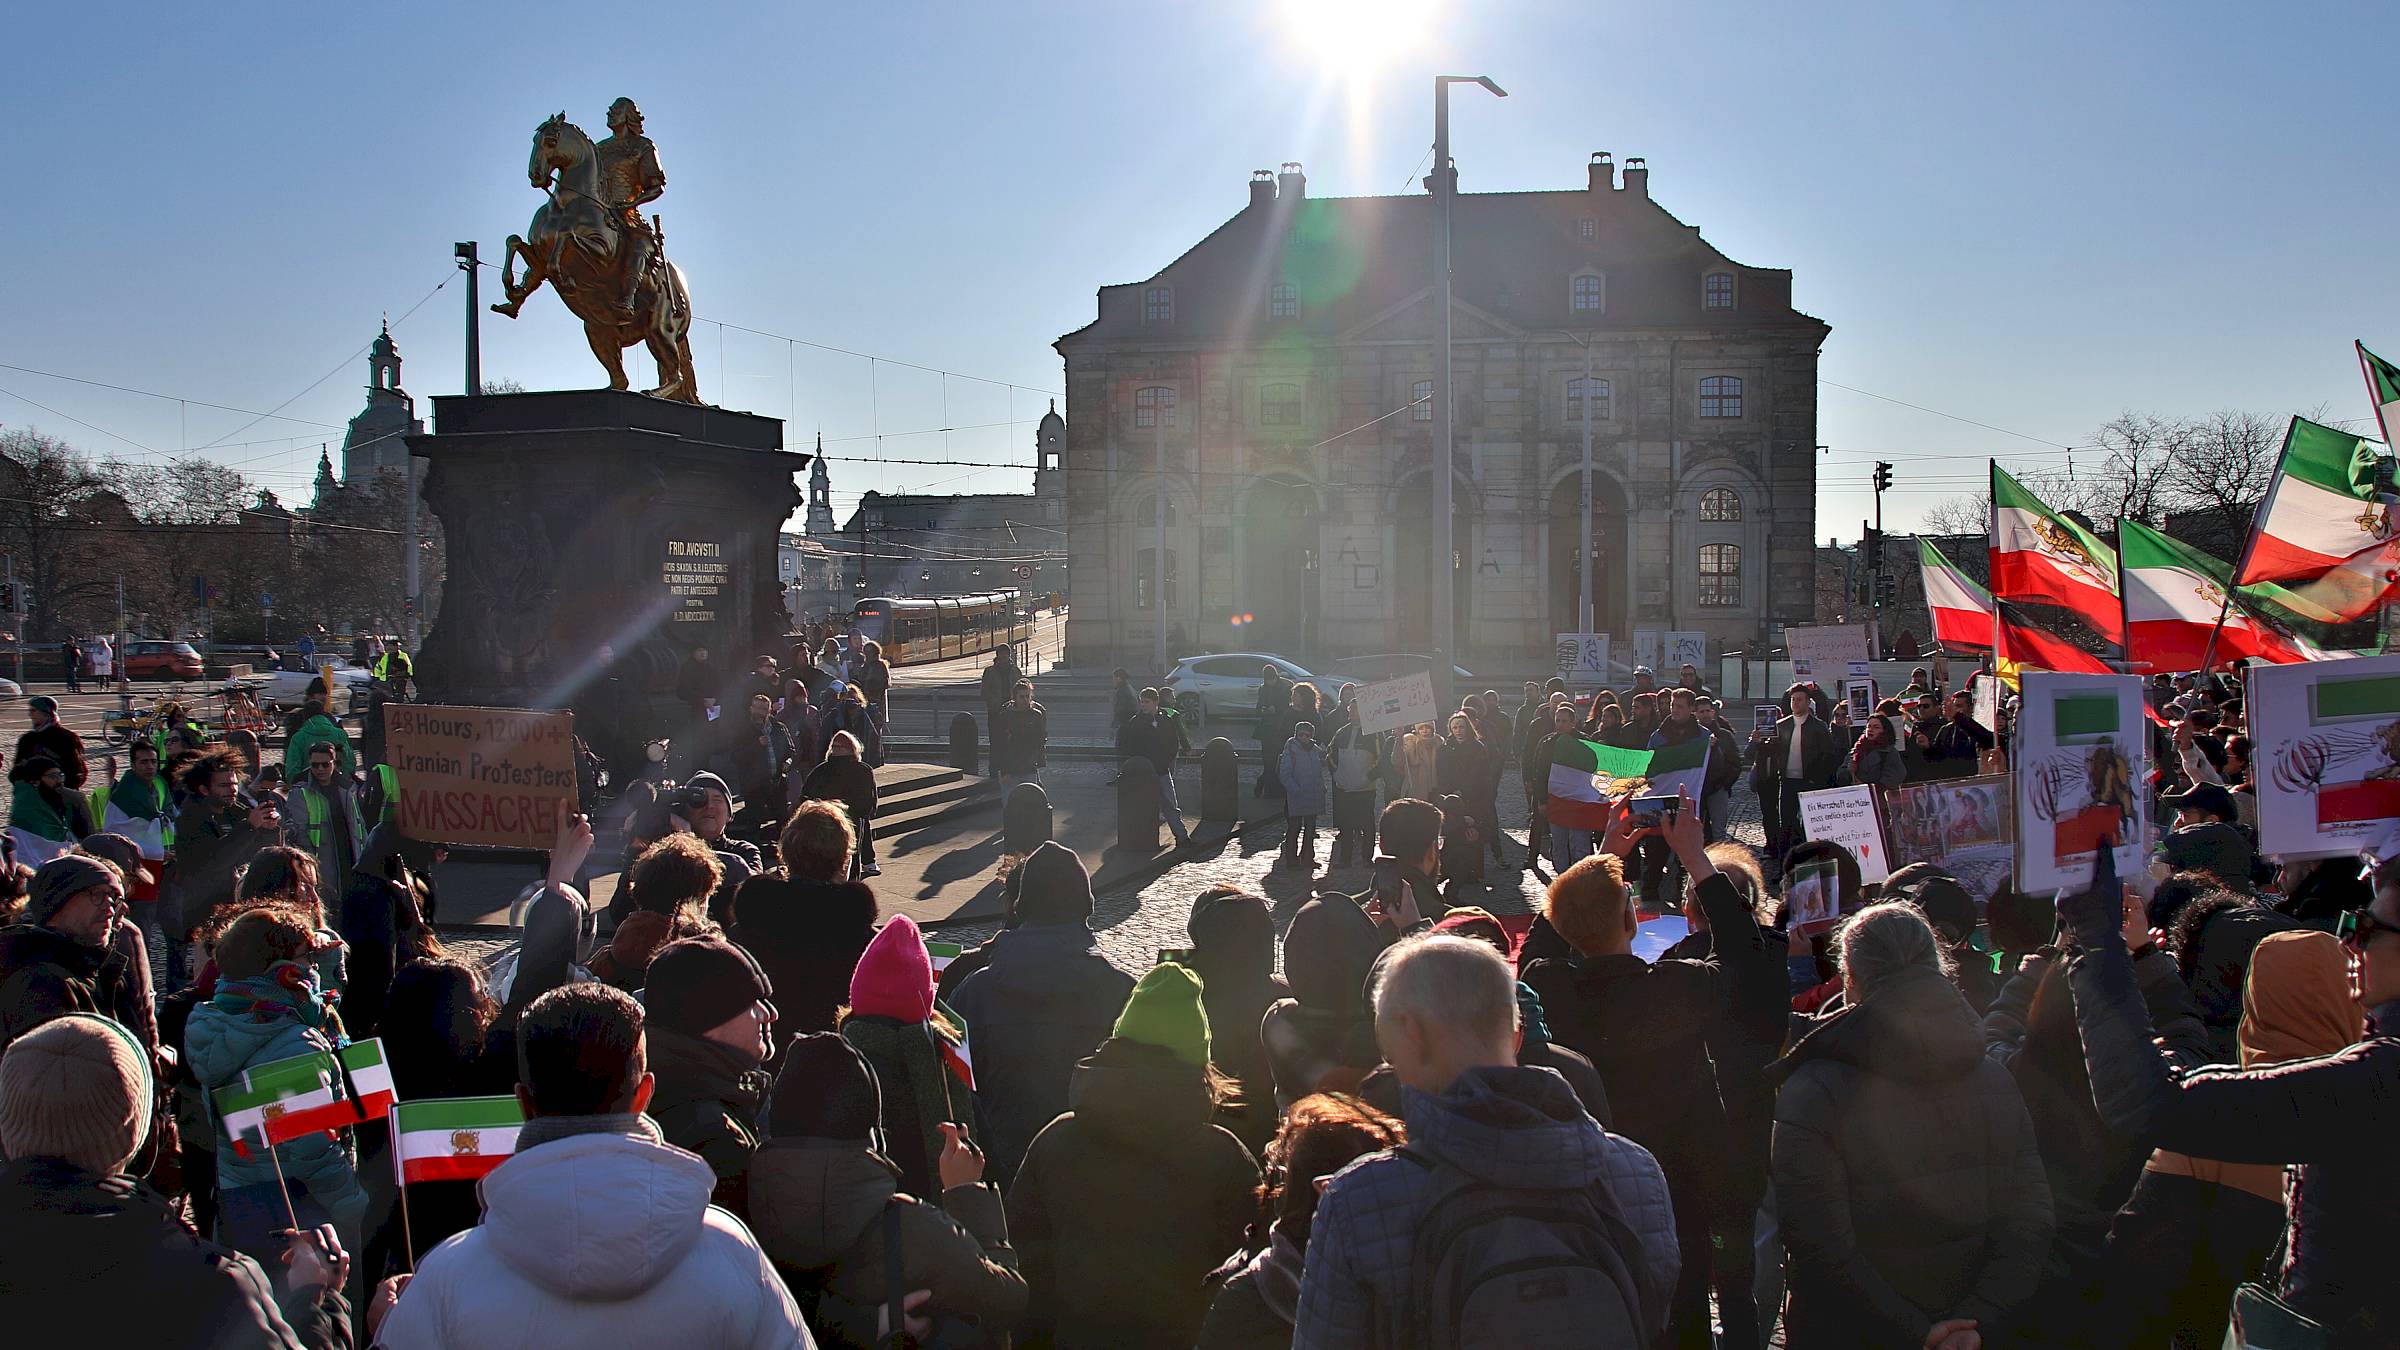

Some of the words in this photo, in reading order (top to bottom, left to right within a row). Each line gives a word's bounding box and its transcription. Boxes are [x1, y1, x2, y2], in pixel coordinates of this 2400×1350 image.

[669, 541, 685, 556] FRID.
[687, 542, 714, 557] AVGVSTI
[684, 586, 689, 595] ET
[391, 711, 413, 736] 48
[416, 714, 480, 743] Hours,
[397, 745, 461, 777] Iranian
[471, 752, 576, 787] Protesters
[1817, 800, 1844, 809] Herrschaft
